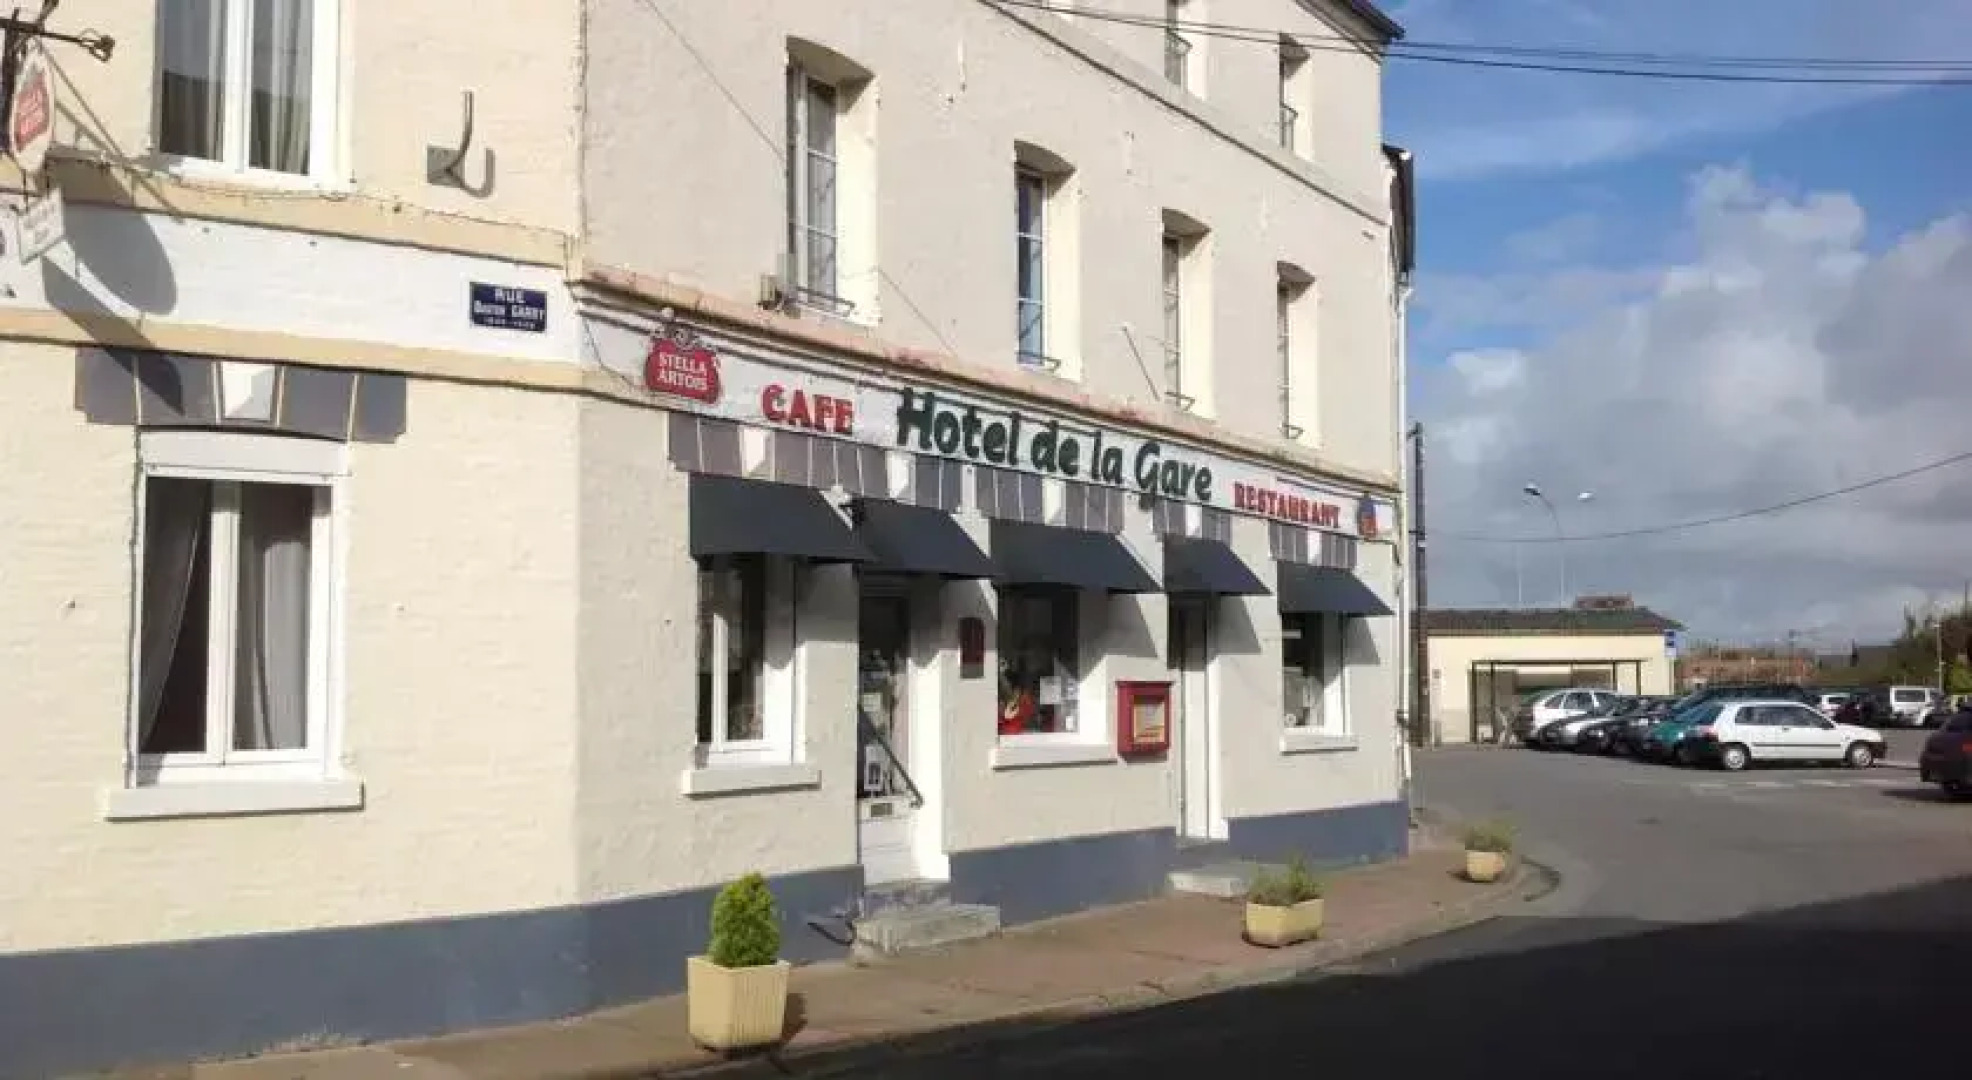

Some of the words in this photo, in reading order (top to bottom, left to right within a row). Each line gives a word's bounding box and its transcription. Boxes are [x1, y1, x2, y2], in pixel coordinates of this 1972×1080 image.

[494, 287, 526, 304] RUE
[657, 368, 708, 391] ARTOIS
[659, 351, 708, 377] STELLA
[761, 384, 854, 434] CAFE
[896, 387, 1020, 466] Hotel
[1030, 419, 1081, 476] de
[1091, 430, 1124, 486] la
[1134, 439, 1214, 512] Gare
[1233, 480, 1341, 529] RESTAURANT
